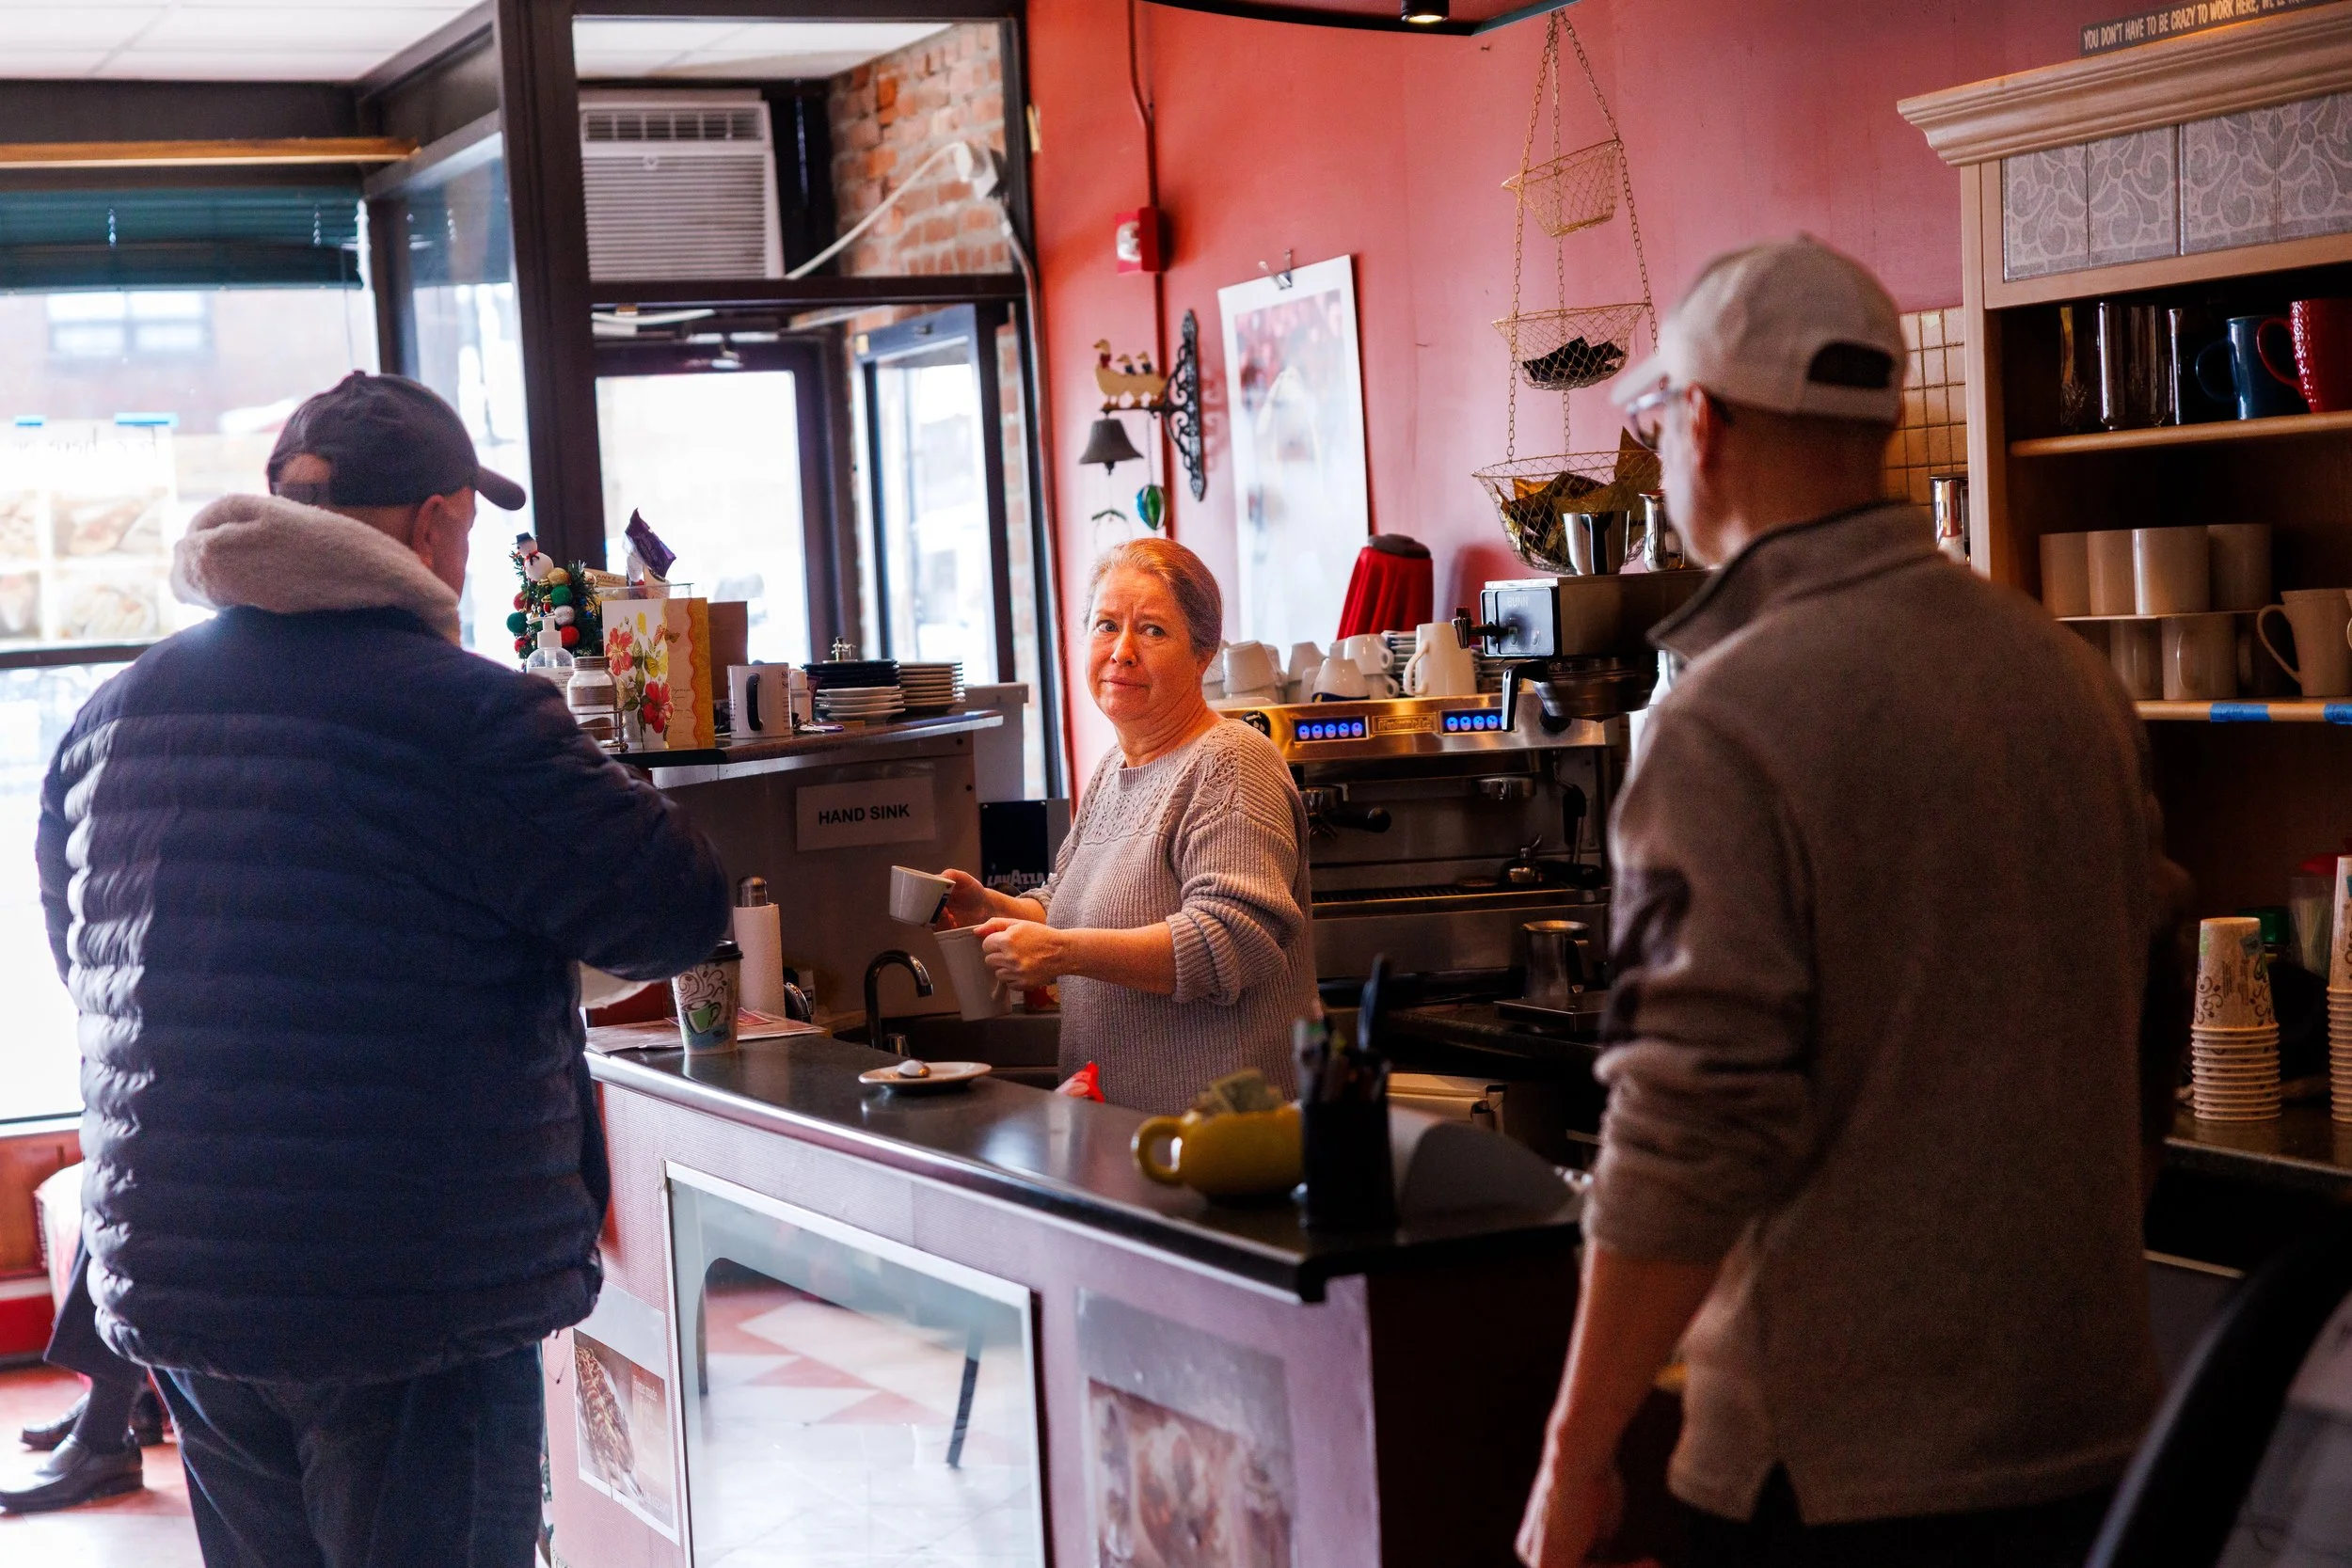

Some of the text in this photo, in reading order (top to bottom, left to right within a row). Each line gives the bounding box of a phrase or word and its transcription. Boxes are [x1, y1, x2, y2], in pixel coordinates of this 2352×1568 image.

[2084, 28, 2099, 51] YOU
[2101, 23, 2123, 47] DON'T
[2125, 17, 2144, 41] HAVE
[2146, 15, 2156, 36] TO
[2158, 12, 2169, 34] BE
[2170, 5, 2196, 30] CRAZY
[2198, 3, 2208, 24] TO
[2210, 0, 2234, 22] WORK
[818, 803, 911, 825] HAND SINK
